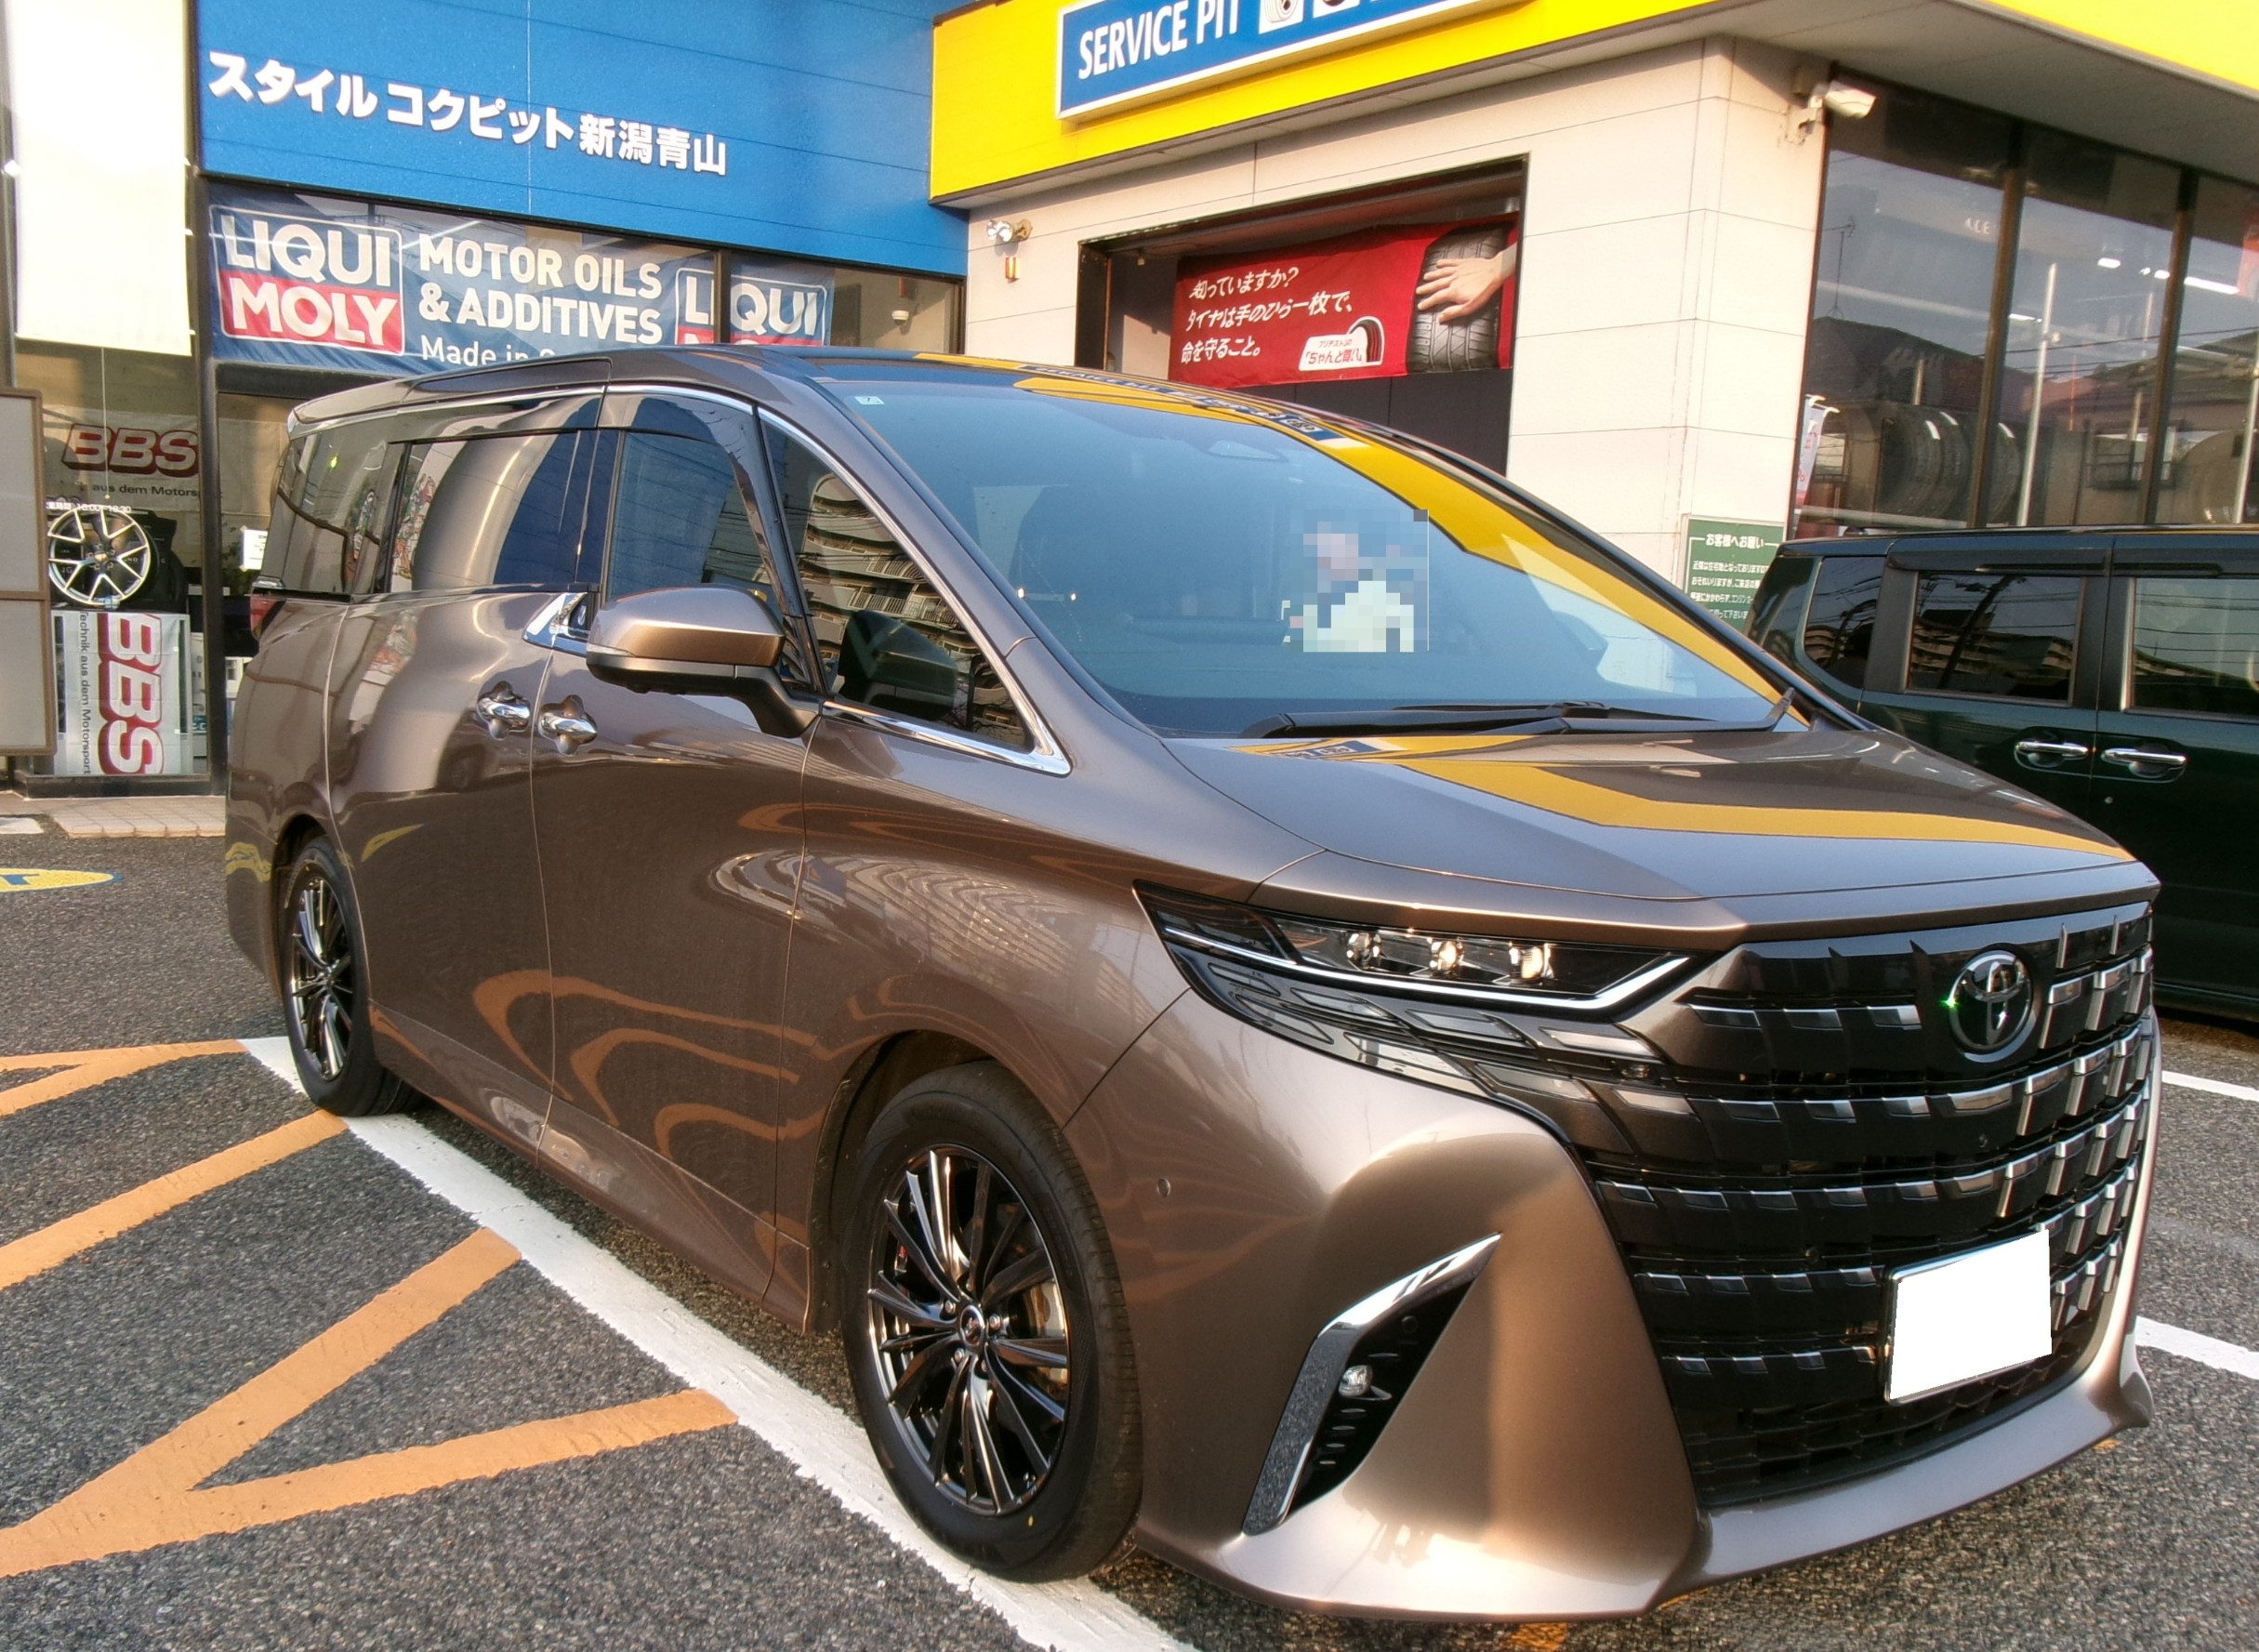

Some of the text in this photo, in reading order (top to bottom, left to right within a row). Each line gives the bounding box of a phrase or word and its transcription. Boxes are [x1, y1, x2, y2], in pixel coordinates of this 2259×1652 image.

[1078, 1, 1188, 79] SERVICE
[220, 214, 391, 288] LIQUI
[418, 233, 663, 299] MOTOR OILS
[229, 277, 398, 347] MOLY
[418, 282, 664, 346] & ADDITIVES
[684, 275, 818, 337] LQUI
[421, 334, 497, 366] Made
[1181, 336, 1262, 364] 命を守ること。
[61, 423, 200, 478] BBS
[92, 483, 202, 498] aus dem Motors
[80, 654, 88, 677] aus
[80, 677, 91, 706] dem
[97, 613, 165, 775] BBS
[81, 708, 92, 775] Motorsport
